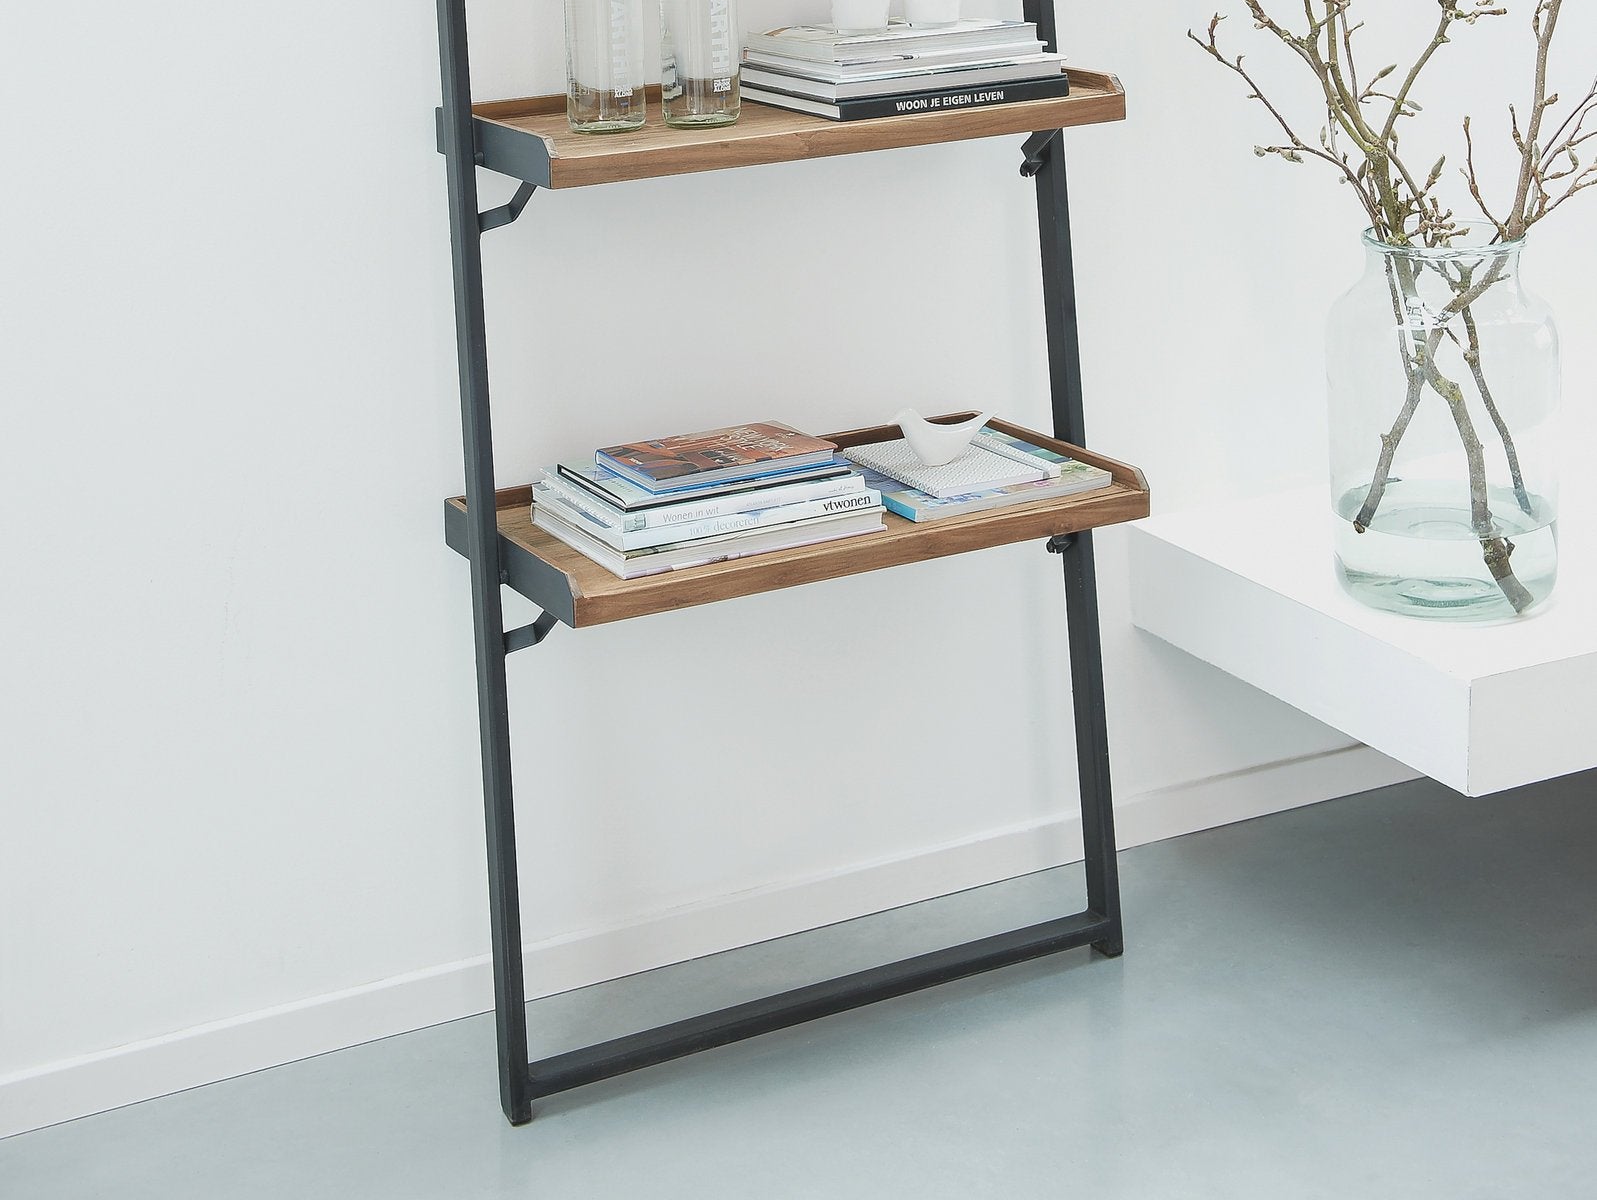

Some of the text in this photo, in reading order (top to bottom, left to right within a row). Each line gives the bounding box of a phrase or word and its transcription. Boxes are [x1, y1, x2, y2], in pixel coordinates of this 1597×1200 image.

[895, 90, 1004, 111] WOON JE EIGEN LEVEN
[823, 495, 871, 512] vtwonen
[662, 506, 719, 523] Wonen in wit
[713, 517, 759, 532] decoreren
